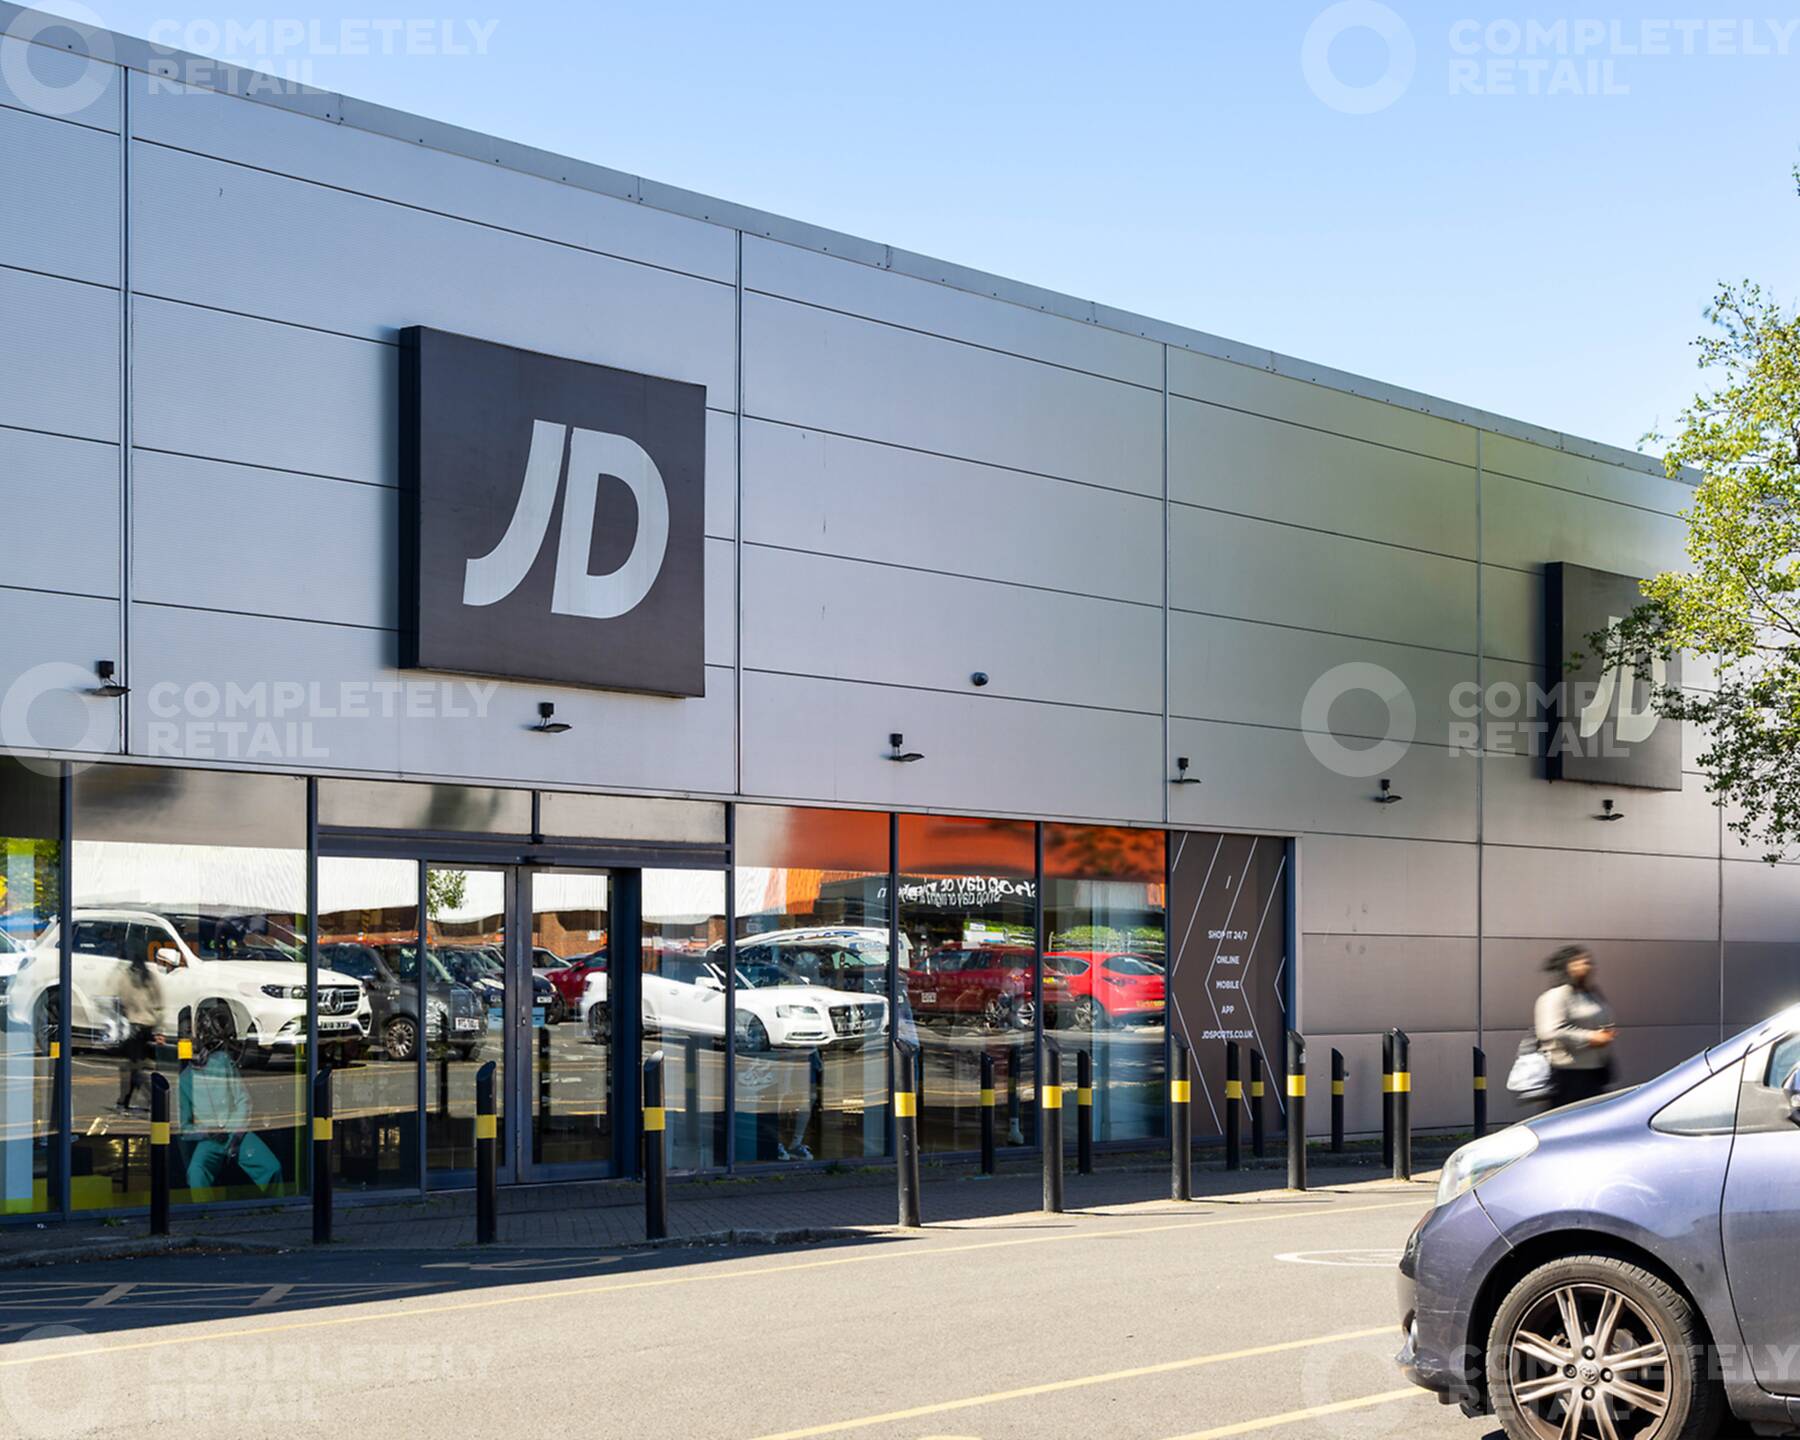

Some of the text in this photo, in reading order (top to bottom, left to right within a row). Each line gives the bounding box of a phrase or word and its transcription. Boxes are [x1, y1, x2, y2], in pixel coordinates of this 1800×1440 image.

[462, 418, 670, 620] JD
[1579, 615, 1667, 743] JD
[1208, 930, 1248, 940] SHOP IT 24/7
[1216, 955, 1240, 965] ONLINE
[1216, 980, 1239, 989] MOBILE
[1221, 1005, 1235, 1014] APP
[1201, 1030, 1254, 1039] JDSPORTS.CO.UK
